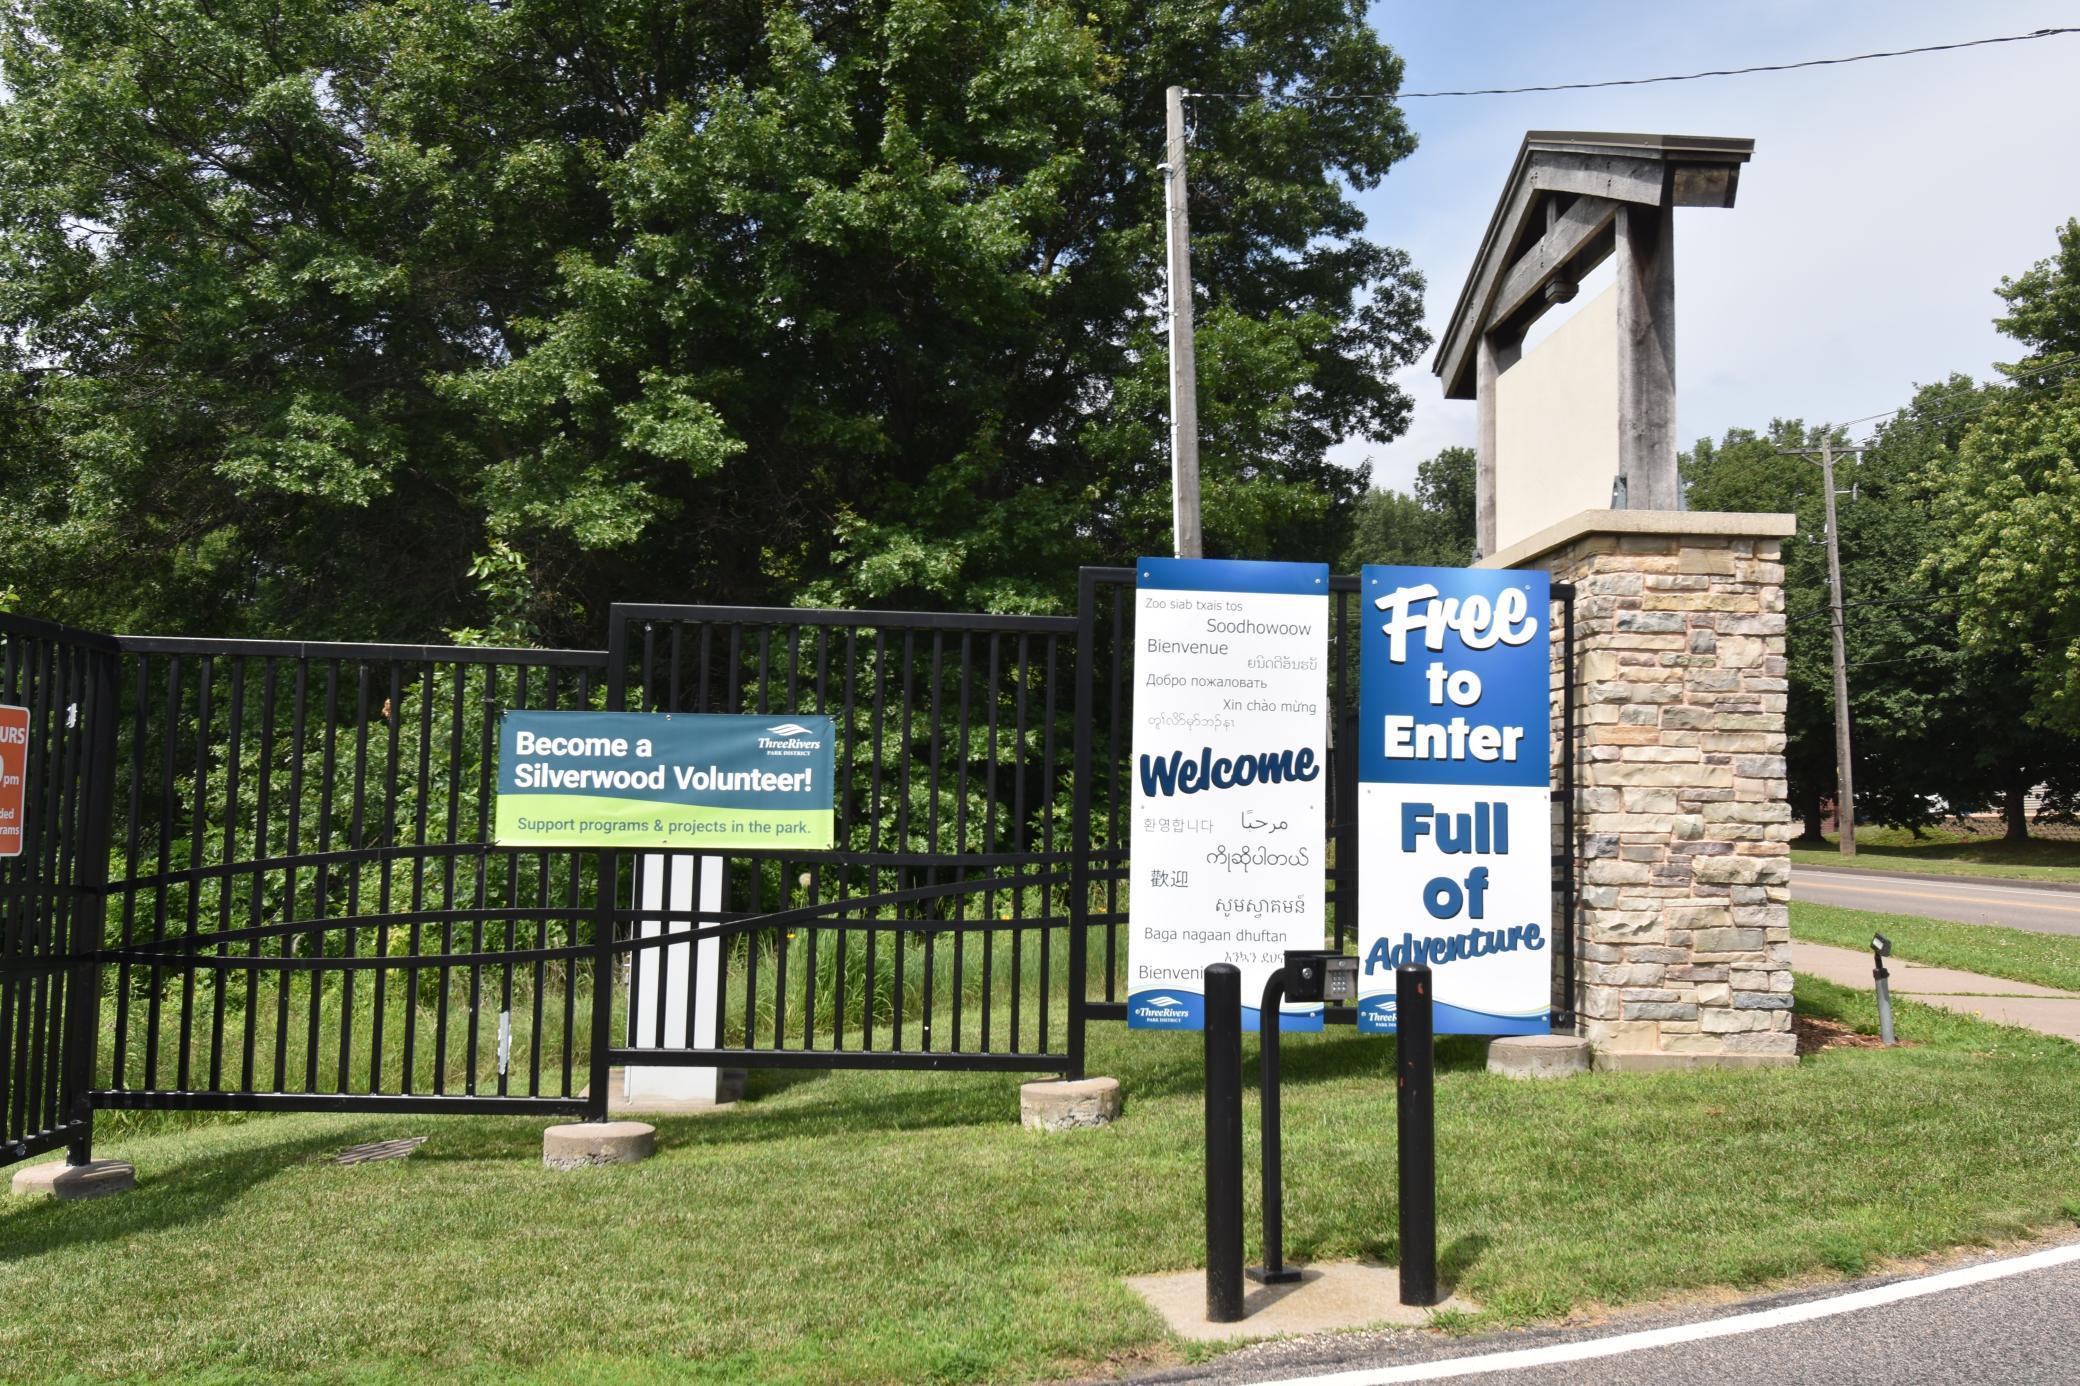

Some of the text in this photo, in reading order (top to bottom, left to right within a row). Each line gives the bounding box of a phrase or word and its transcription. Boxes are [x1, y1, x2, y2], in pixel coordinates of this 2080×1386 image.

[1145, 598, 1243, 611] Zoo siab txais tos
[1206, 618, 1312, 636] Soodhowoow
[1375, 583, 1538, 662] Free
[1147, 638, 1229, 656] Bienvenue
[1146, 674, 1268, 688] Добро пожаловать
[1426, 662, 1482, 706] to
[1223, 699, 1242, 710] Xin
[0, 726, 25, 744] URS
[516, 732, 652, 757] Become a
[758, 737, 821, 750] ThreeRivers
[1384, 715, 1524, 761] Enter
[514, 763, 812, 791] Silverwood Volunteer!
[1139, 746, 1320, 798] Welcome
[0, 826, 20, 836] rams
[518, 817, 812, 837] Support programs & projects in the park.
[1143, 818, 1215, 834] 환영합니다
[1401, 801, 1509, 855] Full
[1150, 868, 1189, 888] 歡迎
[1422, 866, 1489, 920] of
[1144, 928, 1287, 943] Baga nagaan dhuftan
[1364, 922, 1546, 977] Adventure
[1139, 964, 1204, 982] Bienveni
